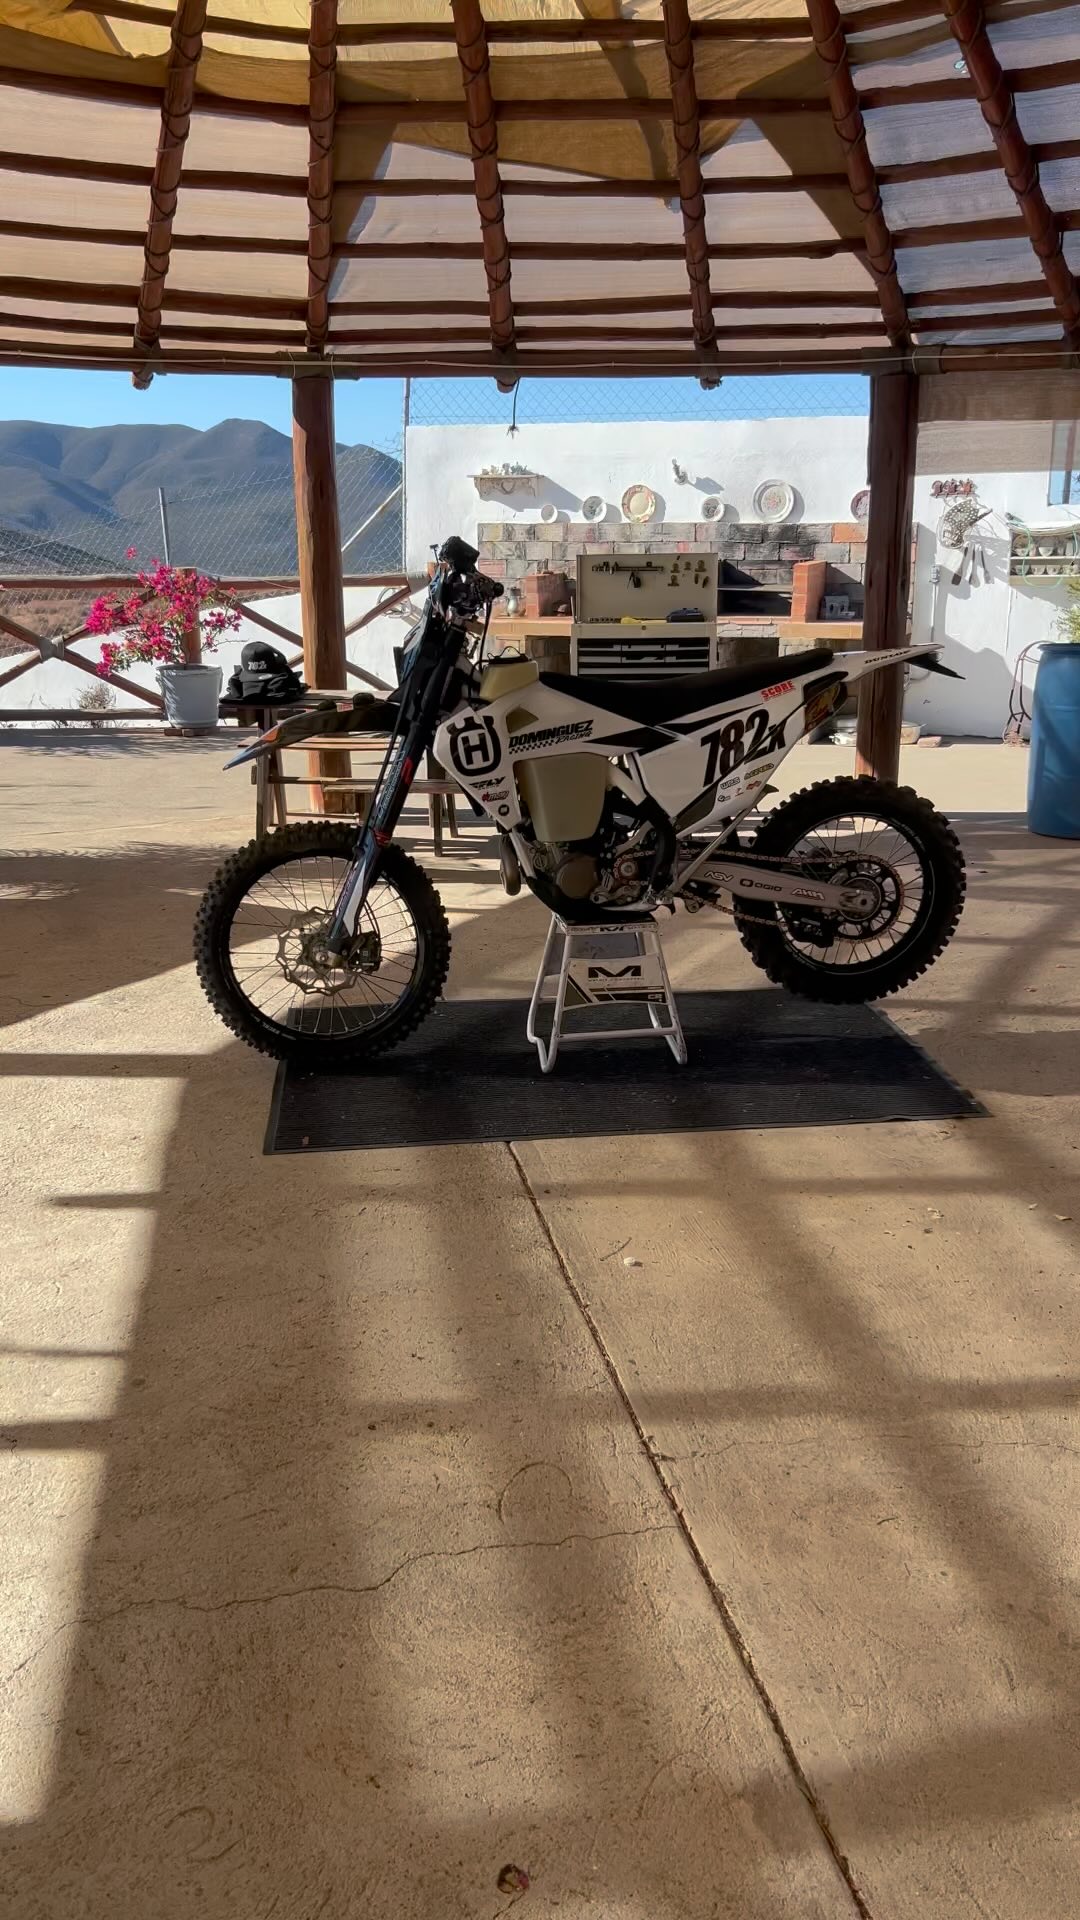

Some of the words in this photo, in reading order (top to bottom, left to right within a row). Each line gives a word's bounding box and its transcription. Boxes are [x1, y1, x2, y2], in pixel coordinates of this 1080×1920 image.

[761, 680, 795, 699] SCORE
[508, 719, 594, 749] DOMINGUEZ
[704, 871, 734, 882] ASV
